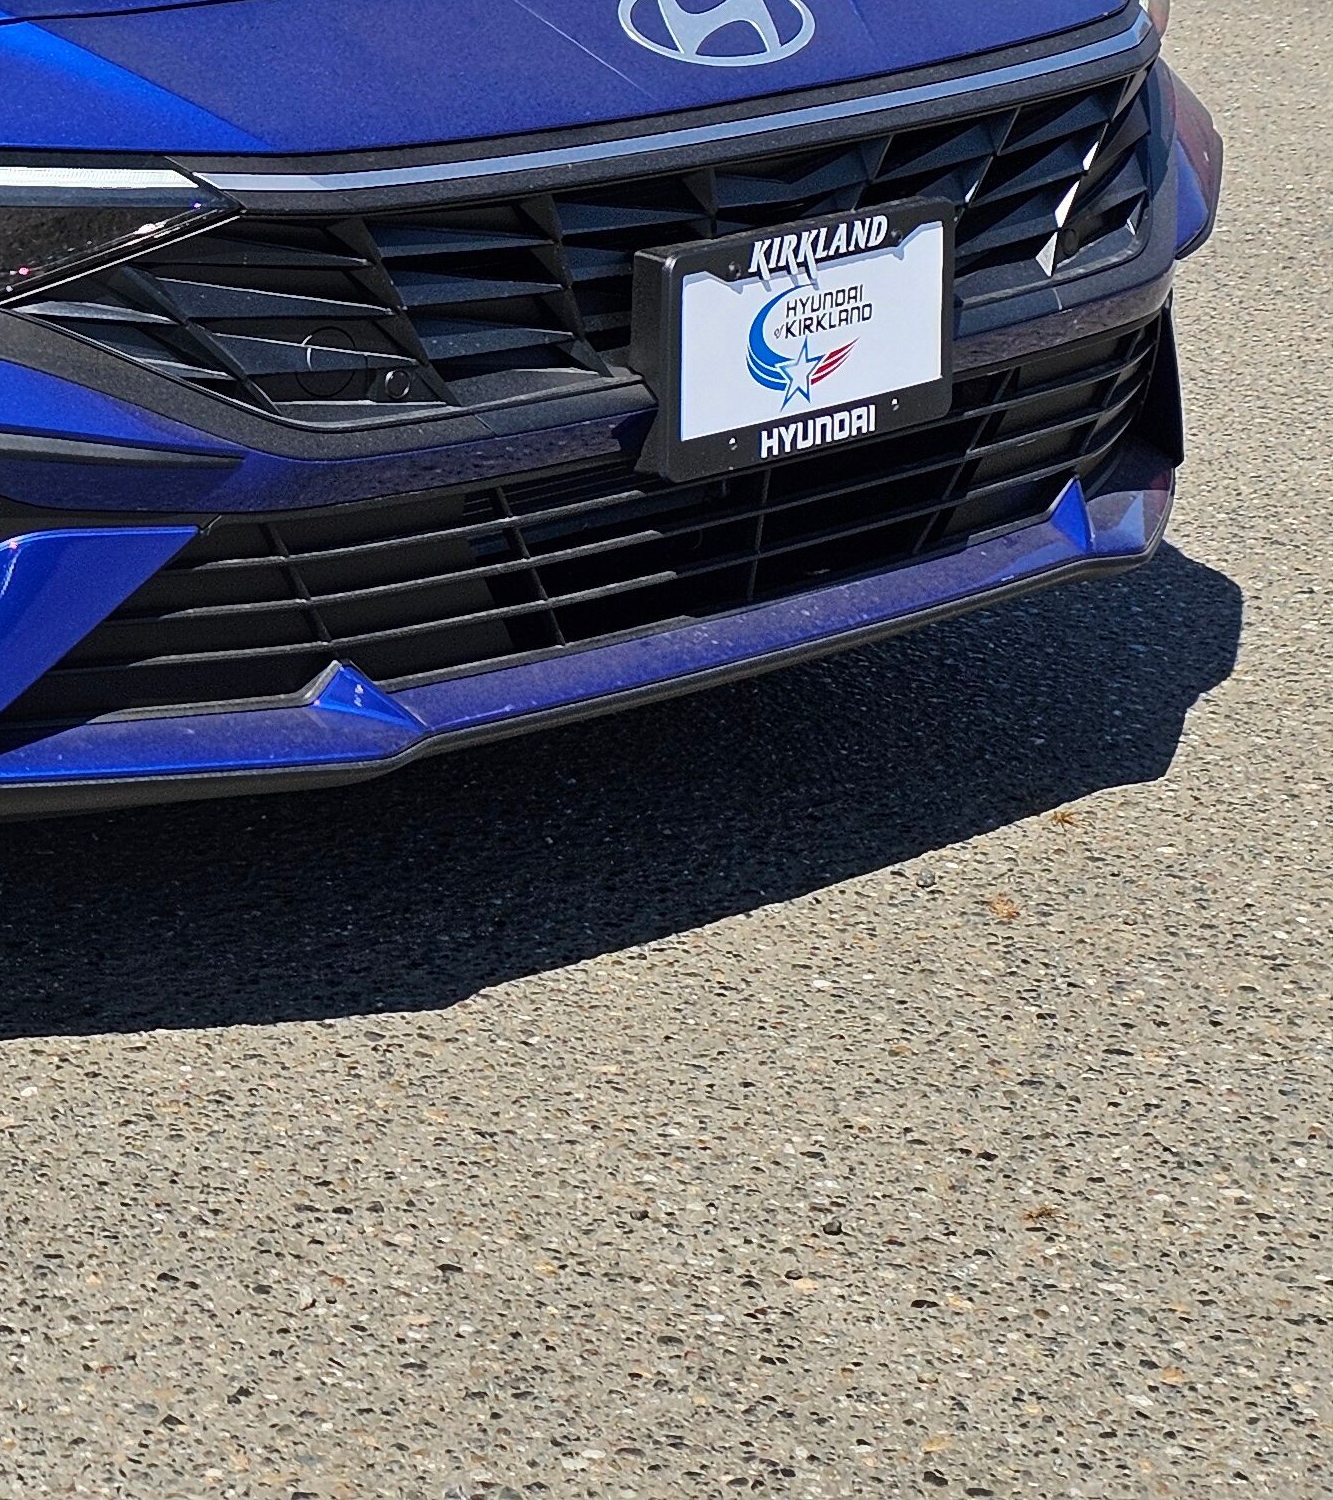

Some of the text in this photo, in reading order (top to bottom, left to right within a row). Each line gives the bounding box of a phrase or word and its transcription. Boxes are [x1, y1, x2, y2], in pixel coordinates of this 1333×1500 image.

[748, 214, 889, 281] KIRKLAND
[784, 302, 874, 340] KIRKLAND
[785, 283, 864, 319] HYUNDAI
[760, 403, 877, 459] HYUNDAI
